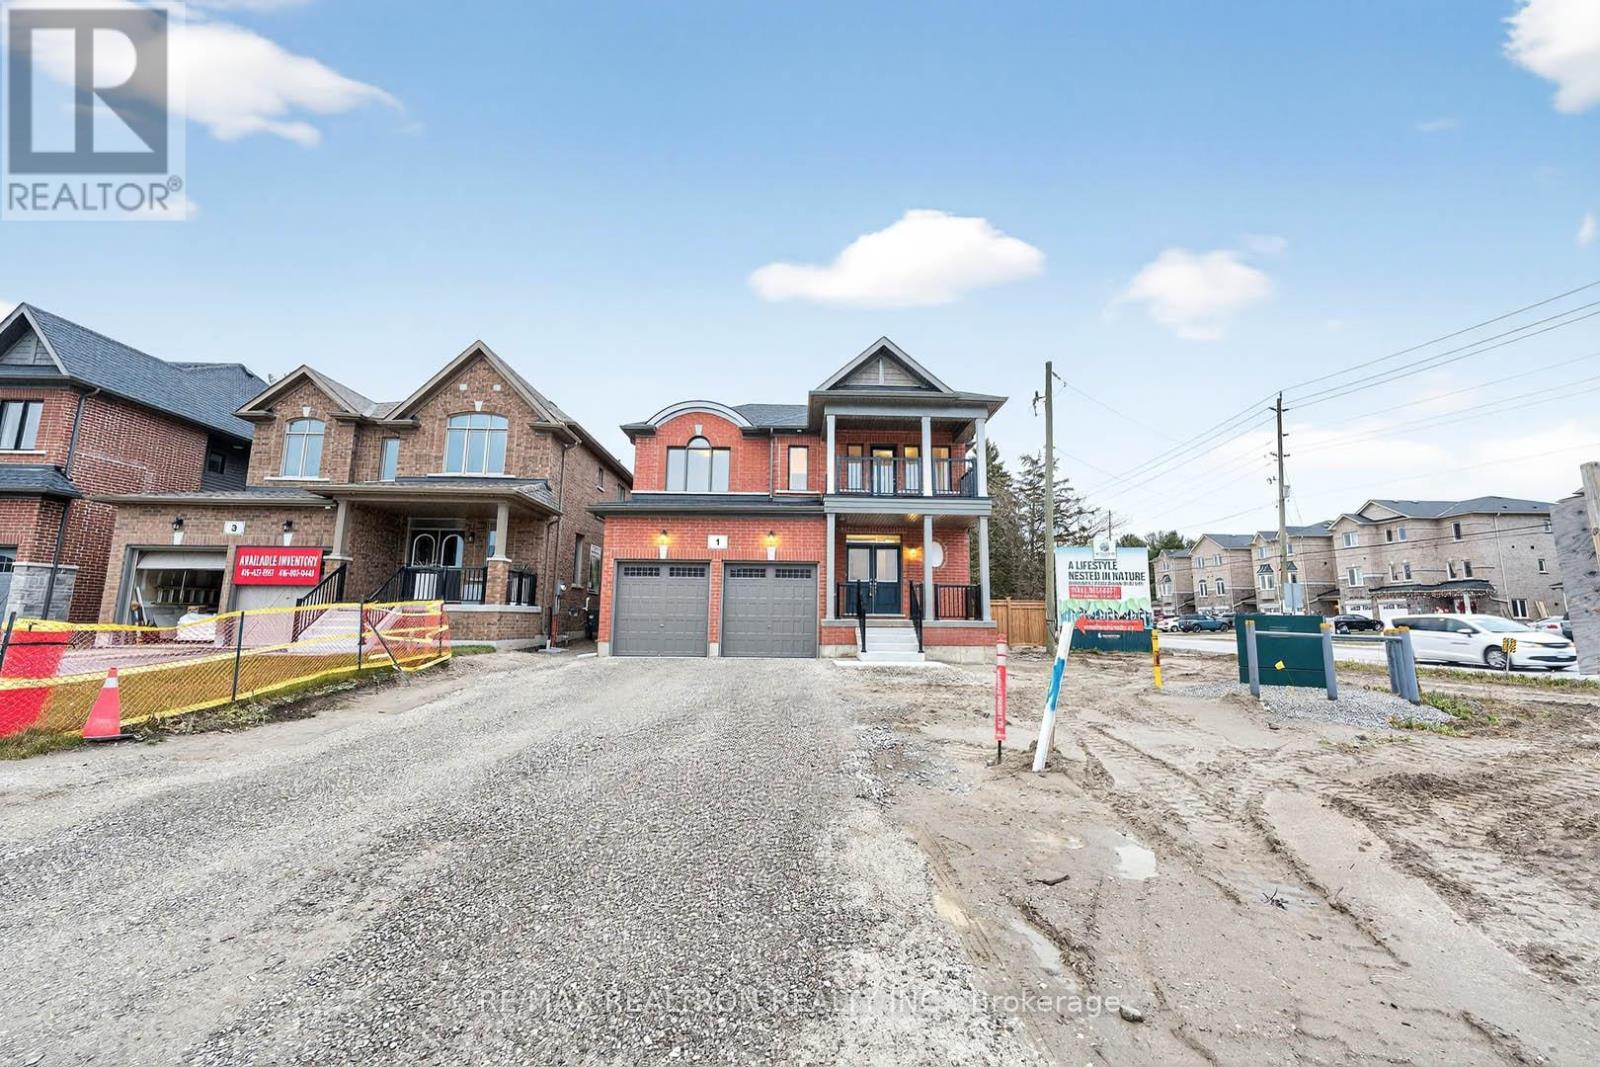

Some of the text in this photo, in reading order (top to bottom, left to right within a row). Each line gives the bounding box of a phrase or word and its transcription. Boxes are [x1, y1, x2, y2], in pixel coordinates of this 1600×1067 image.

[231, 524, 238, 532] 3
[715, 538, 720, 546] 1
[239, 555, 319, 567] AVAILABLE INVENTORY
[1068, 561, 1118, 571] A LIFESTYLE
[1068, 571, 1146, 581] NESTED IN NATURE
